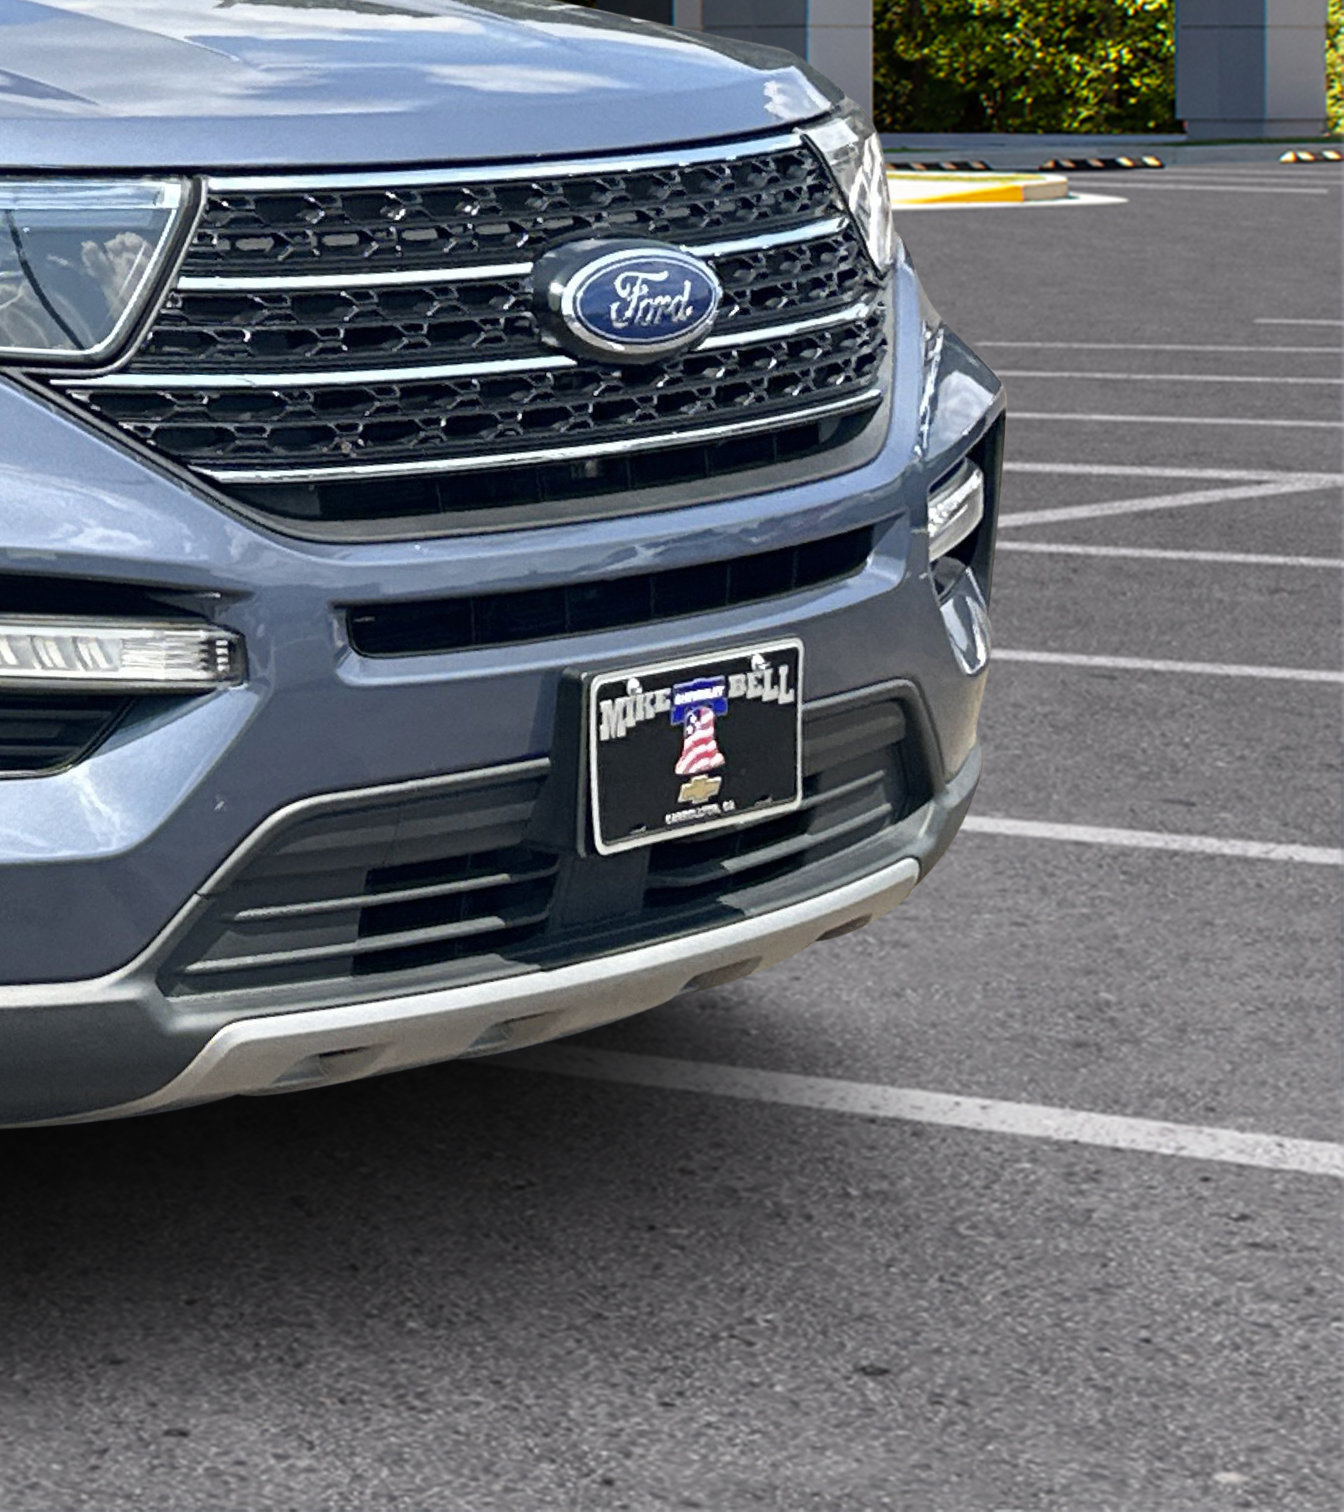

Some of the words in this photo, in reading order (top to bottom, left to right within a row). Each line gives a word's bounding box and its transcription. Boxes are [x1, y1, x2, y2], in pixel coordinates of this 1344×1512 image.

[610, 270, 694, 328] Ford
[599, 688, 672, 741] MIKE
[727, 664, 795, 705] BELL
